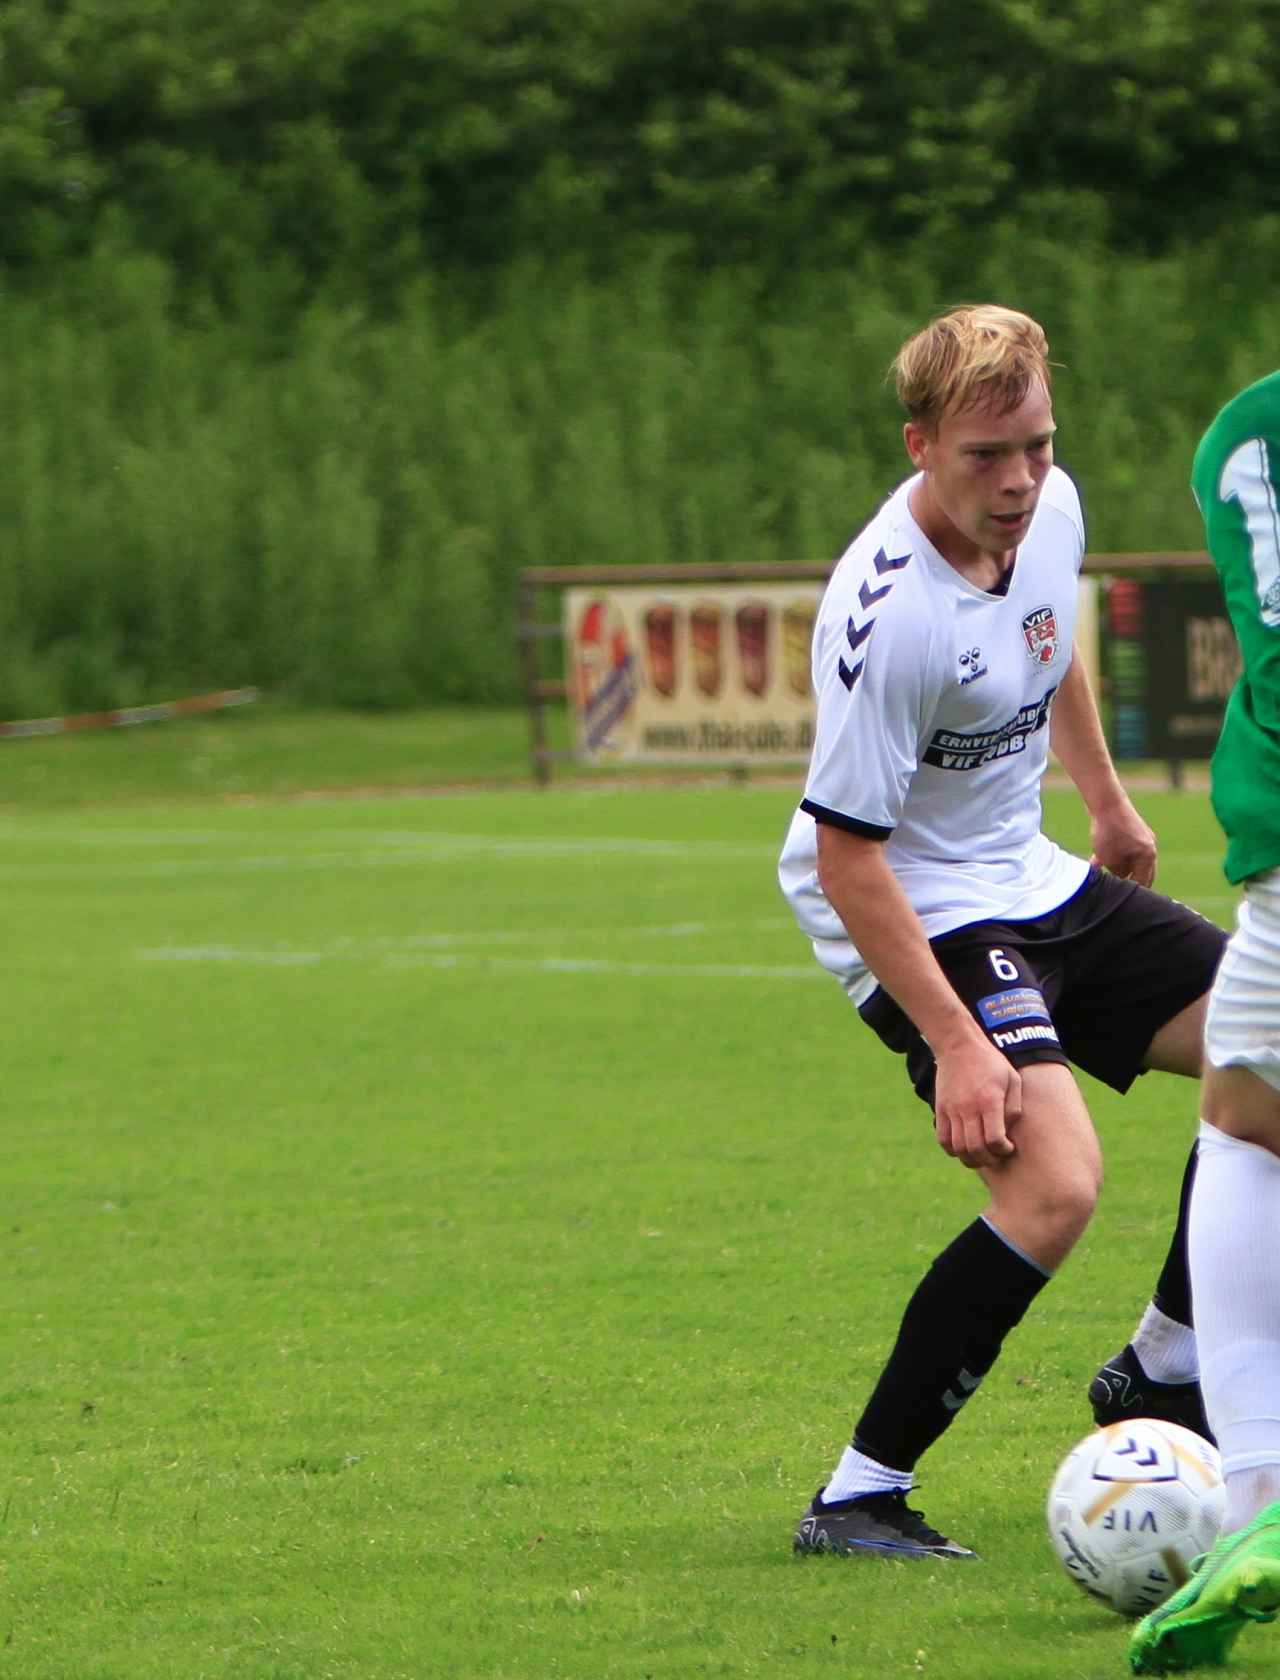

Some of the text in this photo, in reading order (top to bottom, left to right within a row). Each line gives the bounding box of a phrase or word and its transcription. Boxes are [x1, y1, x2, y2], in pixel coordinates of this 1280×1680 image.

[1024, 608, 1052, 627] VIF
[941, 752, 981, 769] VIF
[989, 949, 1019, 981] 6
[1103, 1510, 1158, 1533] VIF
